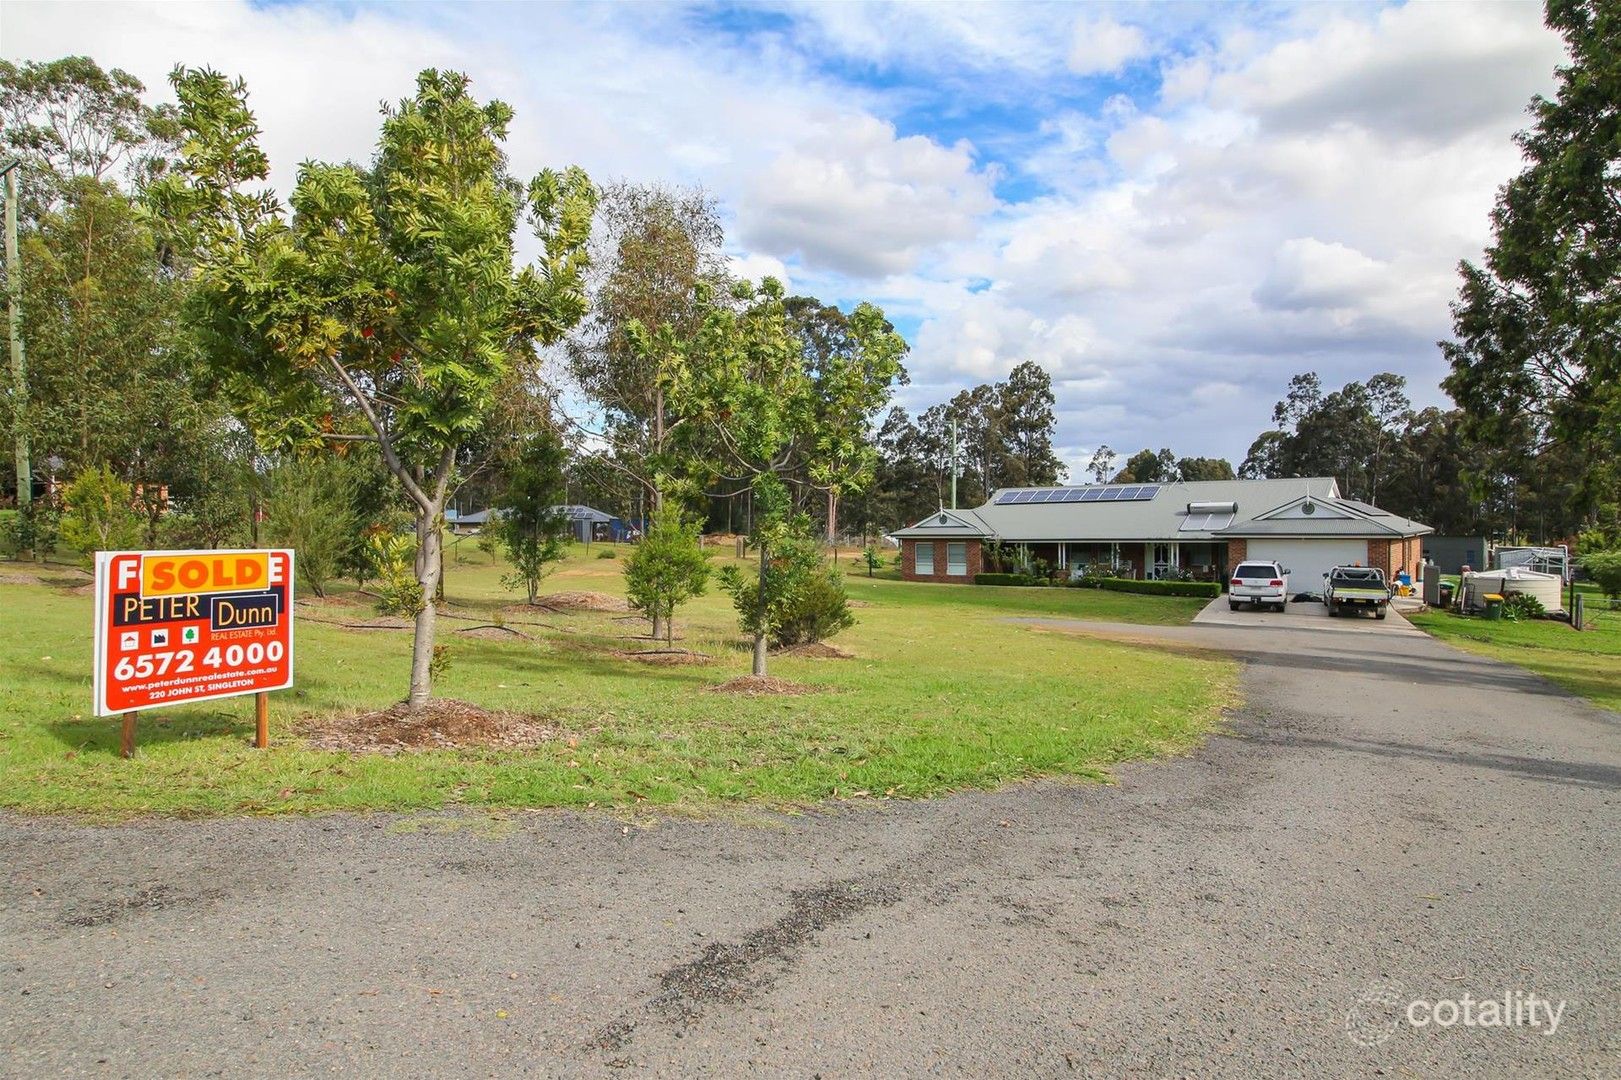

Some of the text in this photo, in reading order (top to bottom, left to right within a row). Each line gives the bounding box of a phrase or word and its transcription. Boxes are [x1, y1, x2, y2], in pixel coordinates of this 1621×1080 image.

[151, 559, 262, 591] SOLD
[124, 595, 200, 622] PETER
[218, 601, 272, 626] Dunn
[211, 632, 228, 641] REAL
[230, 629, 253, 639] ESTATE
[114, 640, 284, 681] 6572 4000
[122, 666, 278, 693] www.peterdunnrealestate.com.au
[149, 690, 165, 700] 220
[167, 687, 193, 697] JOHN
[208, 678, 254, 692] SINGLETON
